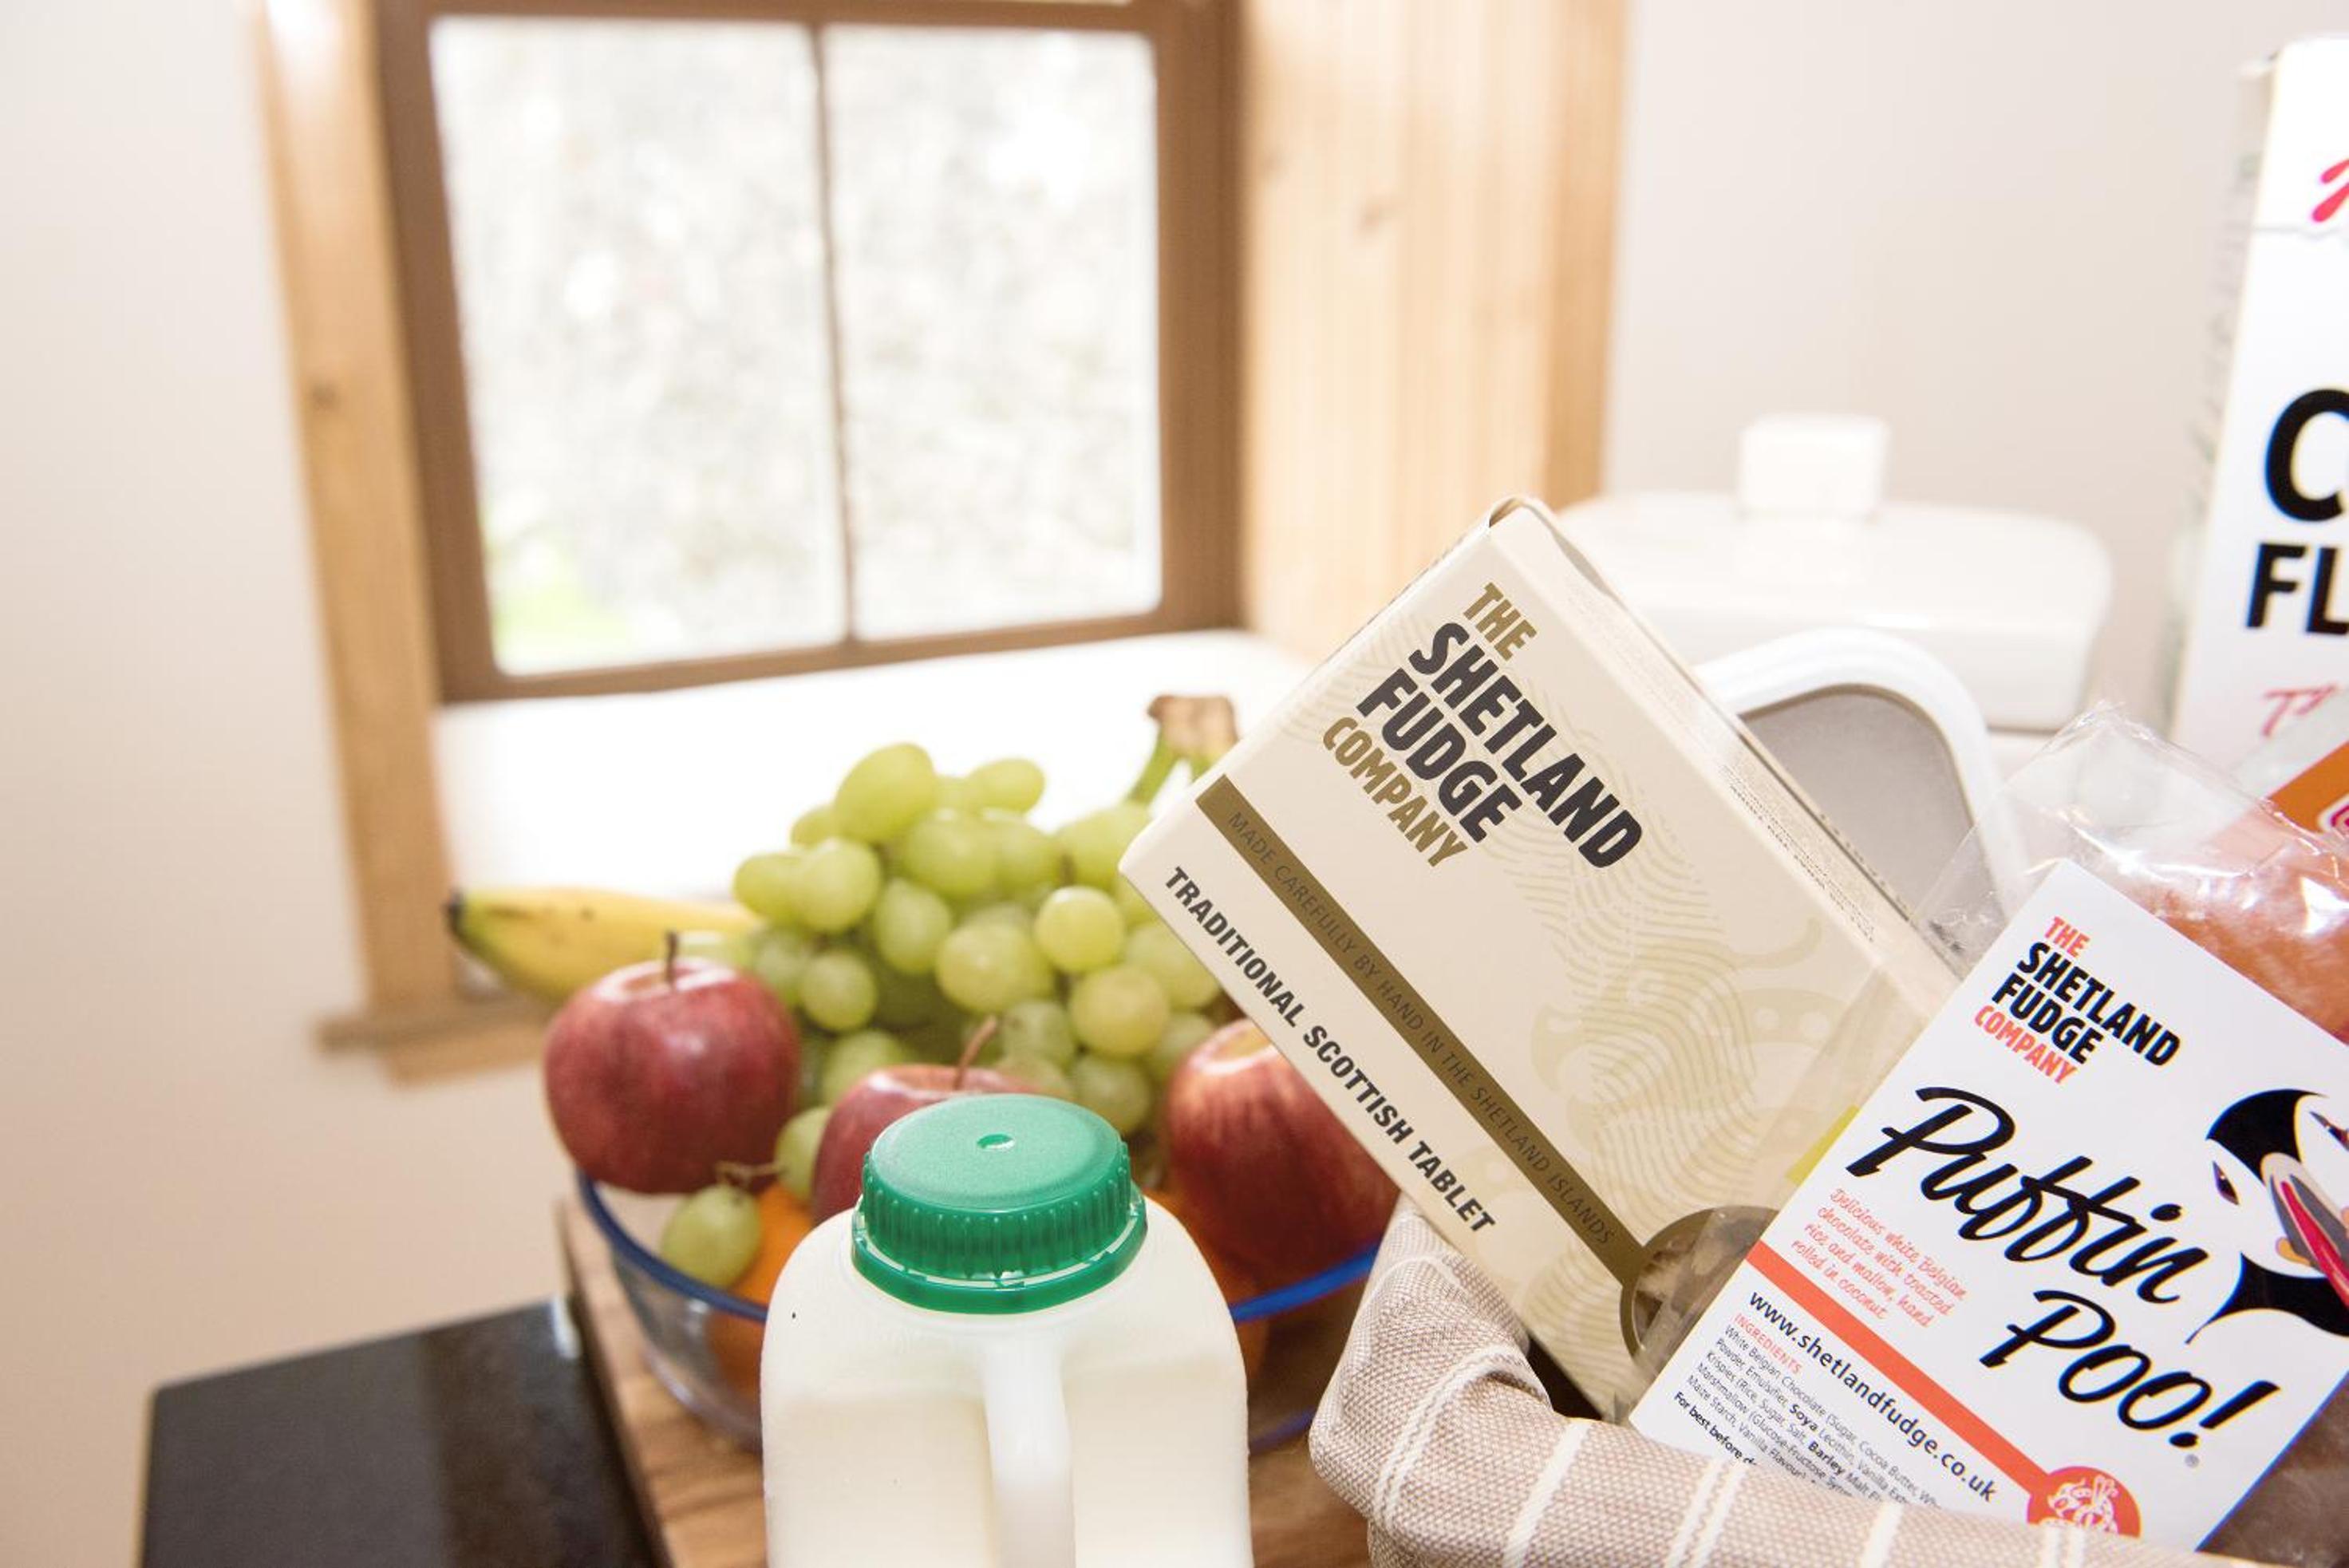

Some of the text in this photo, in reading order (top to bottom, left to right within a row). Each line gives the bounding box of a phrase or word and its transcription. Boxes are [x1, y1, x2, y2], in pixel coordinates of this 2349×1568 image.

[1464, 583, 1537, 661] THE
[1324, 717, 1467, 867] COMPANY
[1356, 669, 1522, 843] FUDGE
[1409, 623, 1642, 867] SHETLAND
[2045, 917, 2089, 958] THE
[1166, 867, 1495, 1231] TRADITIONAL SCOTTISH TABLET
[1229, 812, 1613, 1245] MADE CAREFULLY BY HAND IN THE SHETLAND ISLANDS
[1976, 1006, 2077, 1083] COMPANY
[1992, 974, 2103, 1064] FUDGE
[2017, 942, 2180, 1065] SHETLAND
[1830, 1189, 1967, 1300] Delicious white Belgian
[1846, 1088, 2208, 1303] Puffin
[1791, 1241, 1887, 1319] rolled in coconut
[1805, 1224, 1934, 1328] rice and mallow, hand
[1818, 1207, 1954, 1315] chocolate with toasted
[1697, 1362, 1749, 1414] Marshmallow
[1735, 1313, 1802, 1374] INGREDIENTS
[1750, 1291, 1996, 1503] www.shetlandfudge.co.uk
[1979, 1290, 2280, 1448] Poo!
[1675, 1392, 1690, 1408] For
[1689, 1405, 1710, 1430] best
[1709, 1425, 1742, 1459] before
[1688, 1375, 1711, 1400] Maize
[1710, 1397, 1736, 1428] Starch,
[1739, 1423, 1768, 1453] Vanilla
[1707, 1350, 1736, 1383] Krispies
[1735, 1378, 1757, 1404] (Rice,
[1759, 1399, 1787, 1427] Sugar,
[1808, 1441, 1845, 1475] Barley
[1716, 1338, 1745, 1369] Powder,
[1790, 1404, 1818, 1432] Soya
[1857, 1461, 1889, 1491] Vanilla
[1725, 1325, 1749, 1350] White
[1749, 1347, 1781, 1379] Belgian
[1782, 1376, 1826, 1416] Chocolate
[1826, 1414, 1857, 1445] (Sugar,
[1859, 1441, 1888, 1470] Cocoa
[1888, 1466, 1918, 1496] Butter,
